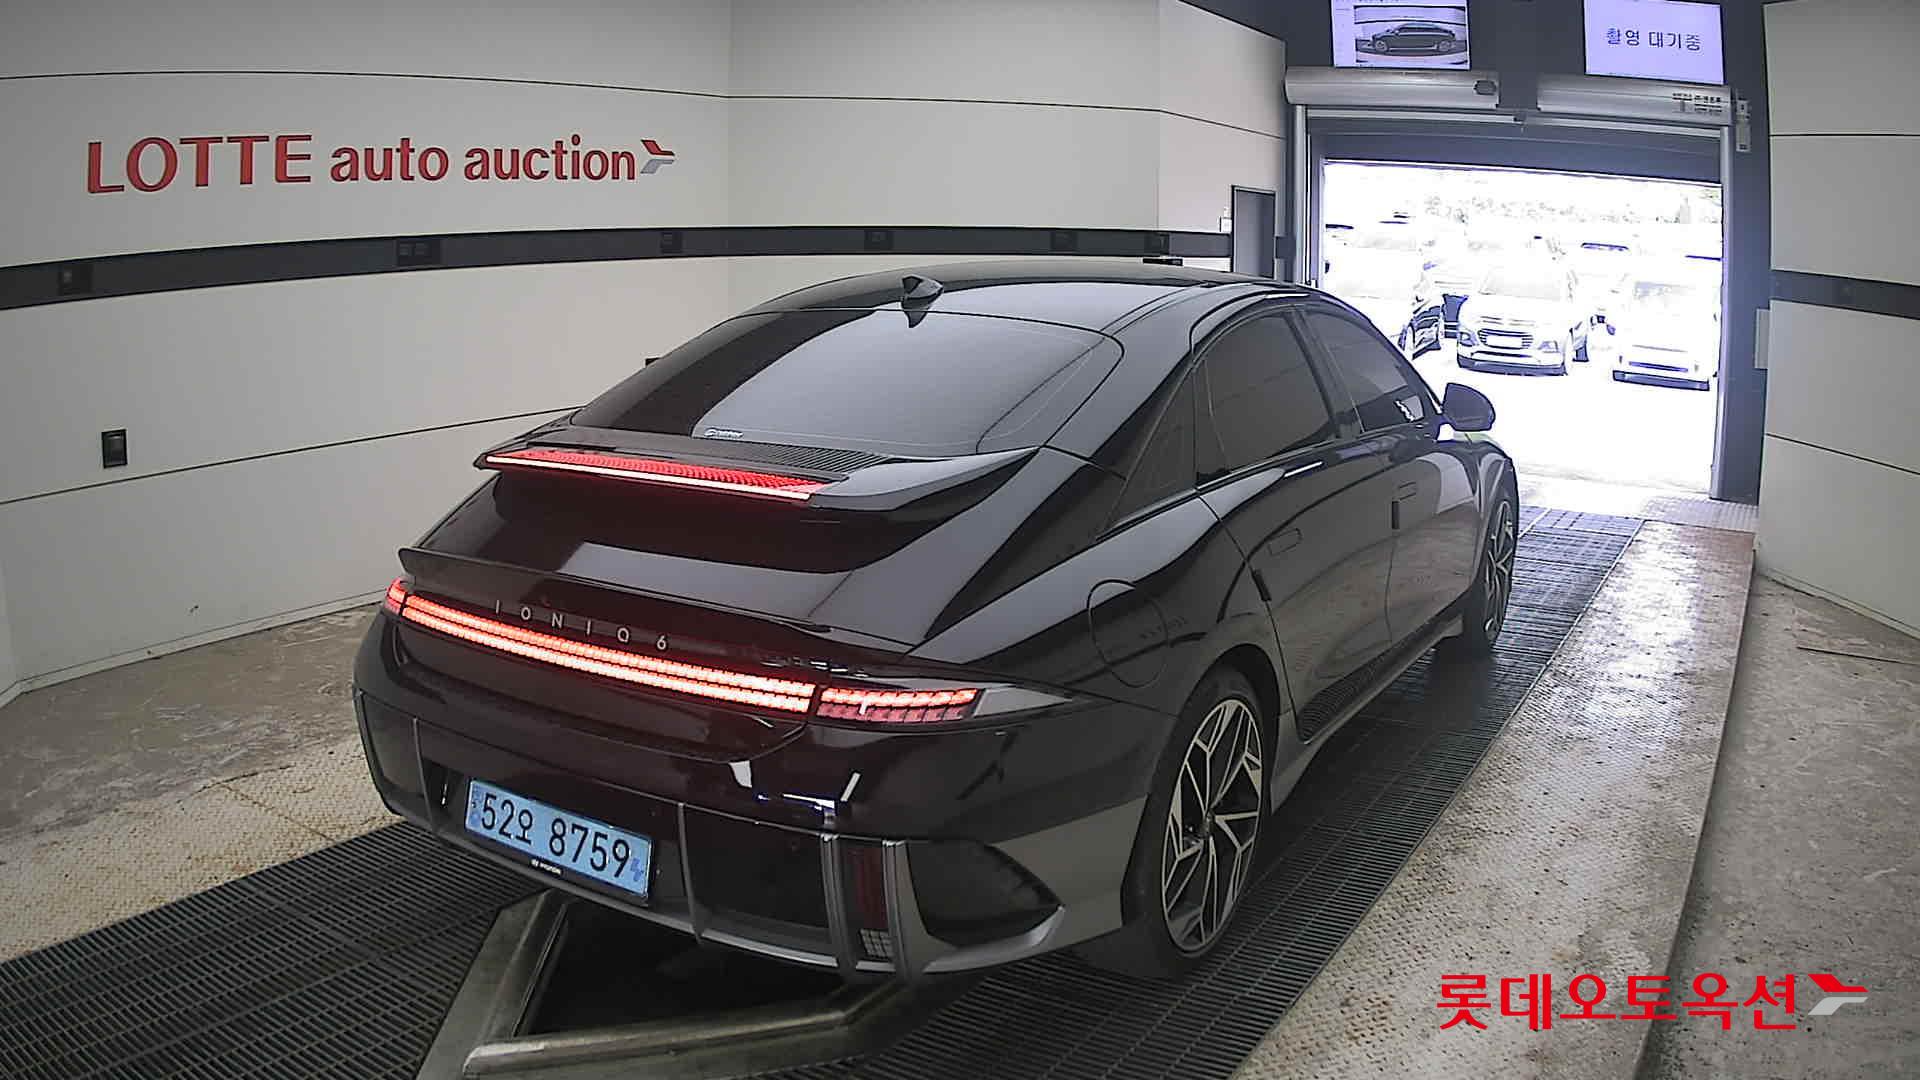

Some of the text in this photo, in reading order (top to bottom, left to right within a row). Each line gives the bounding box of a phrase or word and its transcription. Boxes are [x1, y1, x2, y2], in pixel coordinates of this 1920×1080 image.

[1648, 31, 1701, 51] 대기중
[88, 134, 636, 194] LOTTE auto auction
[495, 600, 668, 651] IONIQ 6
[481, 792, 533, 846] 52오
[549, 818, 630, 878] 8759
